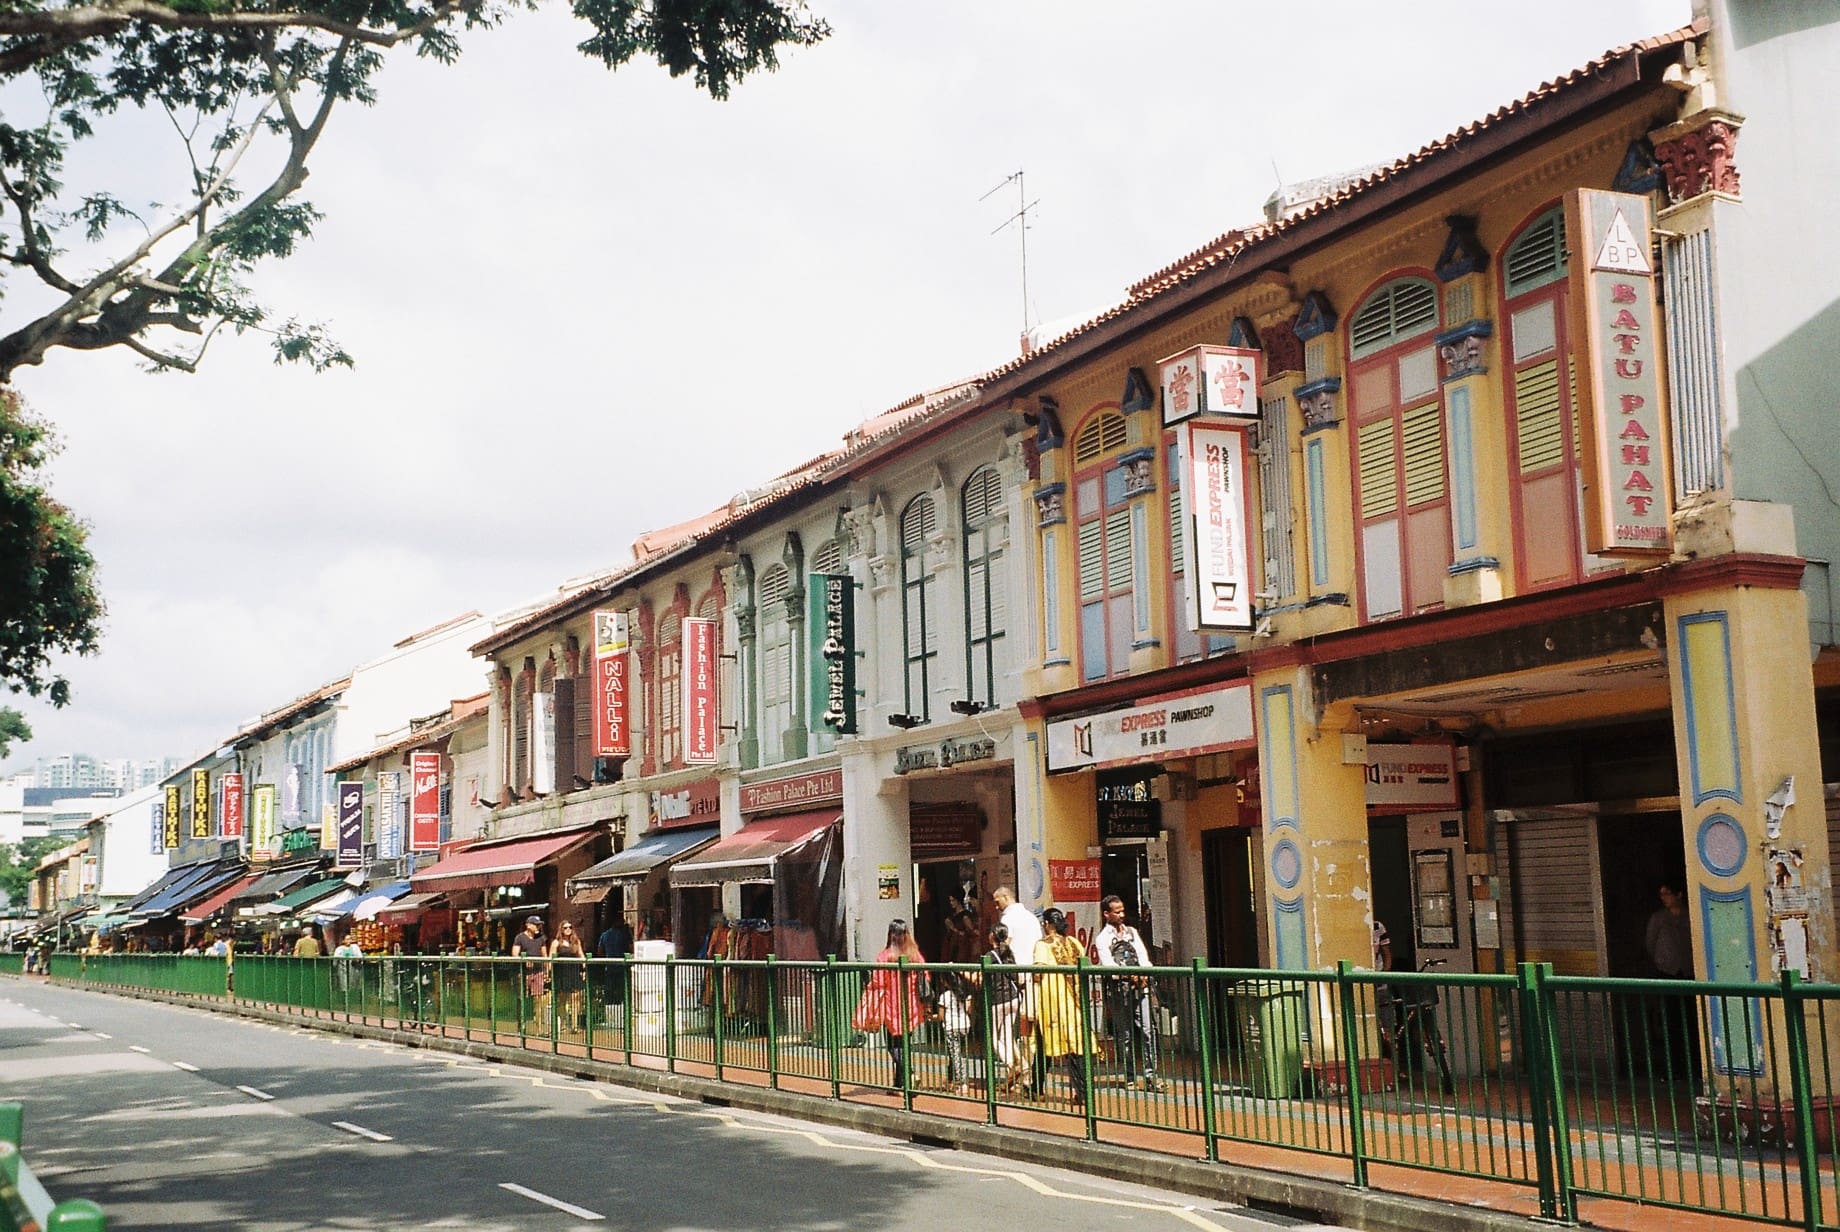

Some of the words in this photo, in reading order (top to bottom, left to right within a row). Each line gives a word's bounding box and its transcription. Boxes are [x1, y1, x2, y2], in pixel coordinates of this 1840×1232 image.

[1610, 281, 1643, 379] BATU
[1213, 359, 1251, 410] 當
[1222, 446, 1231, 494] PAWNSHOP
[1618, 393, 1655, 517] PAHAT
[1205, 443, 1223, 528] EXPRESS
[823, 580, 846, 660] PALACE
[697, 624, 708, 690] Fashion
[823, 659, 847, 728] JEWEL
[1120, 709, 1167, 733] EXPRESS
[1170, 704, 1214, 726] PAWNSHOP
[756, 786, 782, 805] Fashion
[783, 783, 806, 800] Palace
[807, 780, 819, 796] Pte
[820, 775, 834, 793] Ltd
[1407, 763, 1449, 774] EXPRESS
[1068, 880, 1099, 889] EXPRESS
